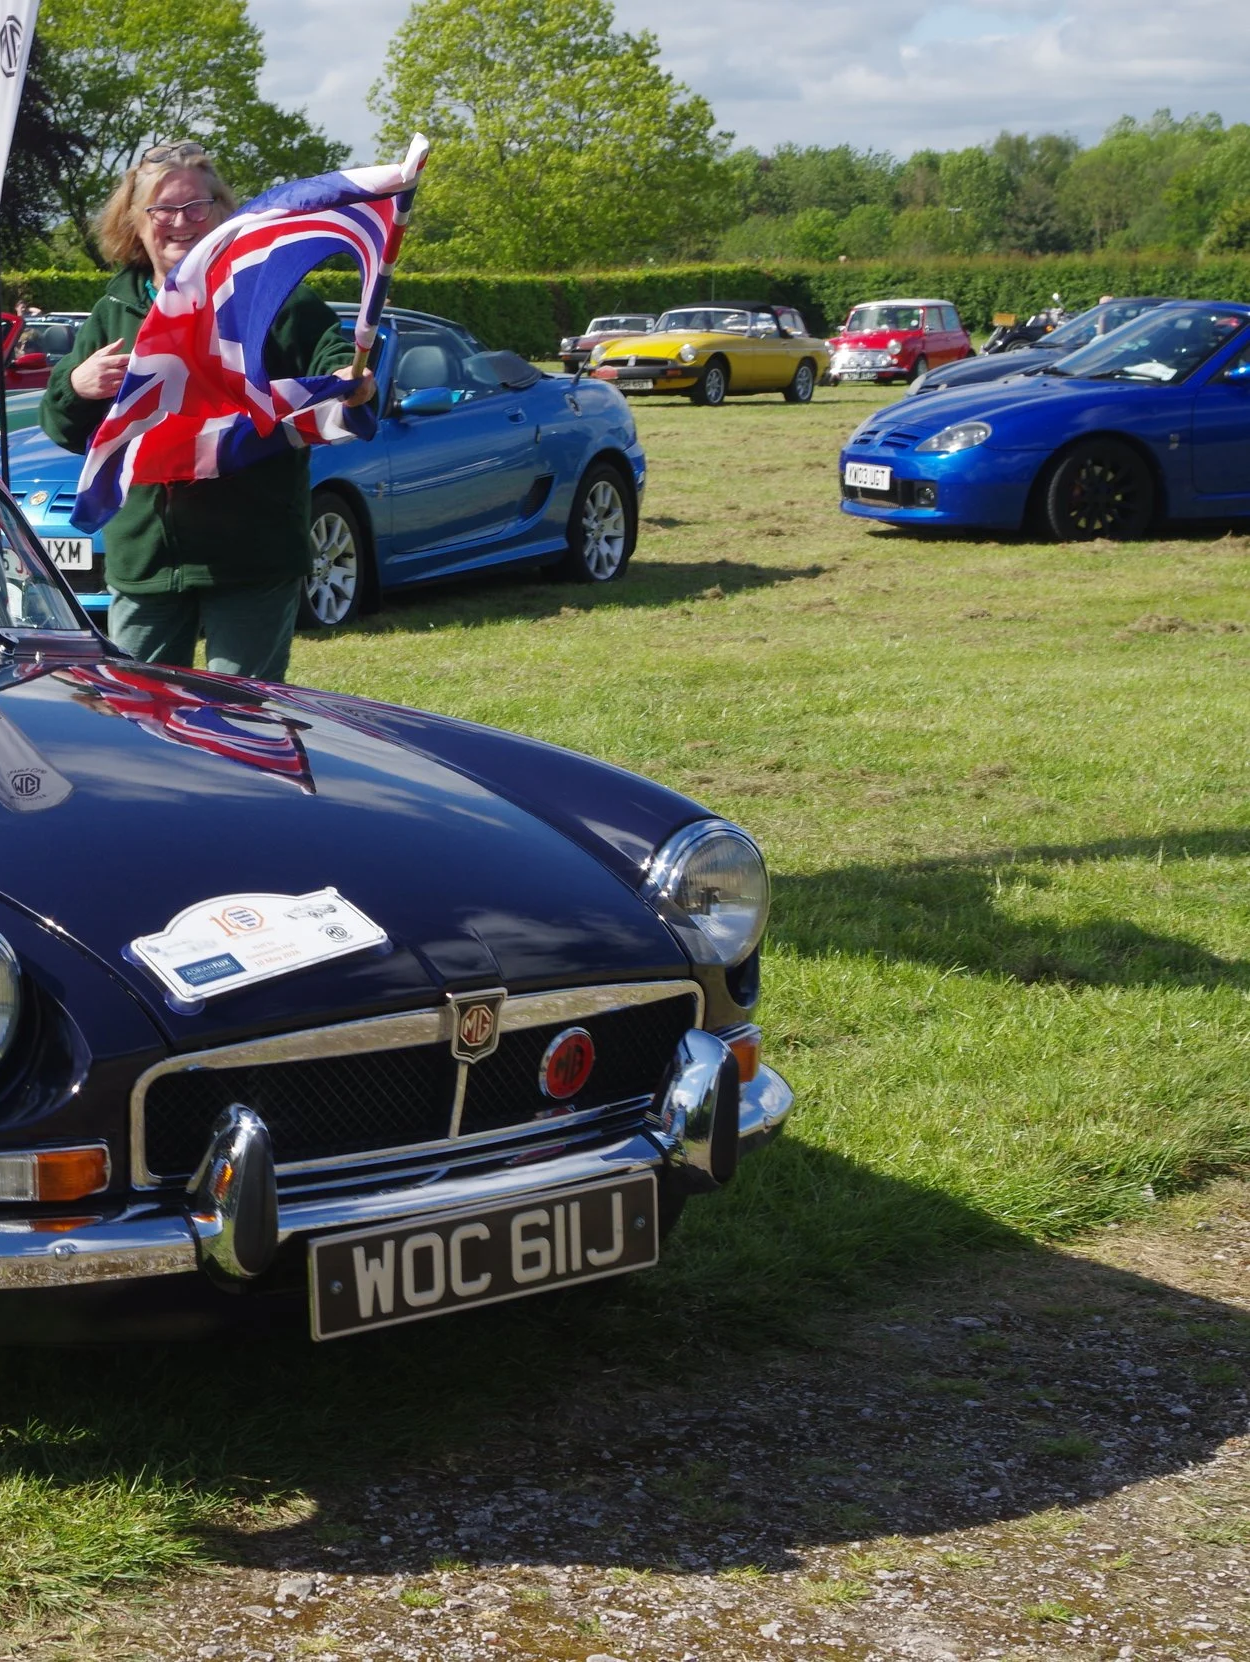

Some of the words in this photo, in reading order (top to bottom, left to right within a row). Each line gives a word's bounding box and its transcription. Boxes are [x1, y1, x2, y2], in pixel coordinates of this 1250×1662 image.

[462, 1006, 493, 1044] MG
[353, 1222, 492, 1319] WOC
[510, 1191, 625, 1284] 611J
